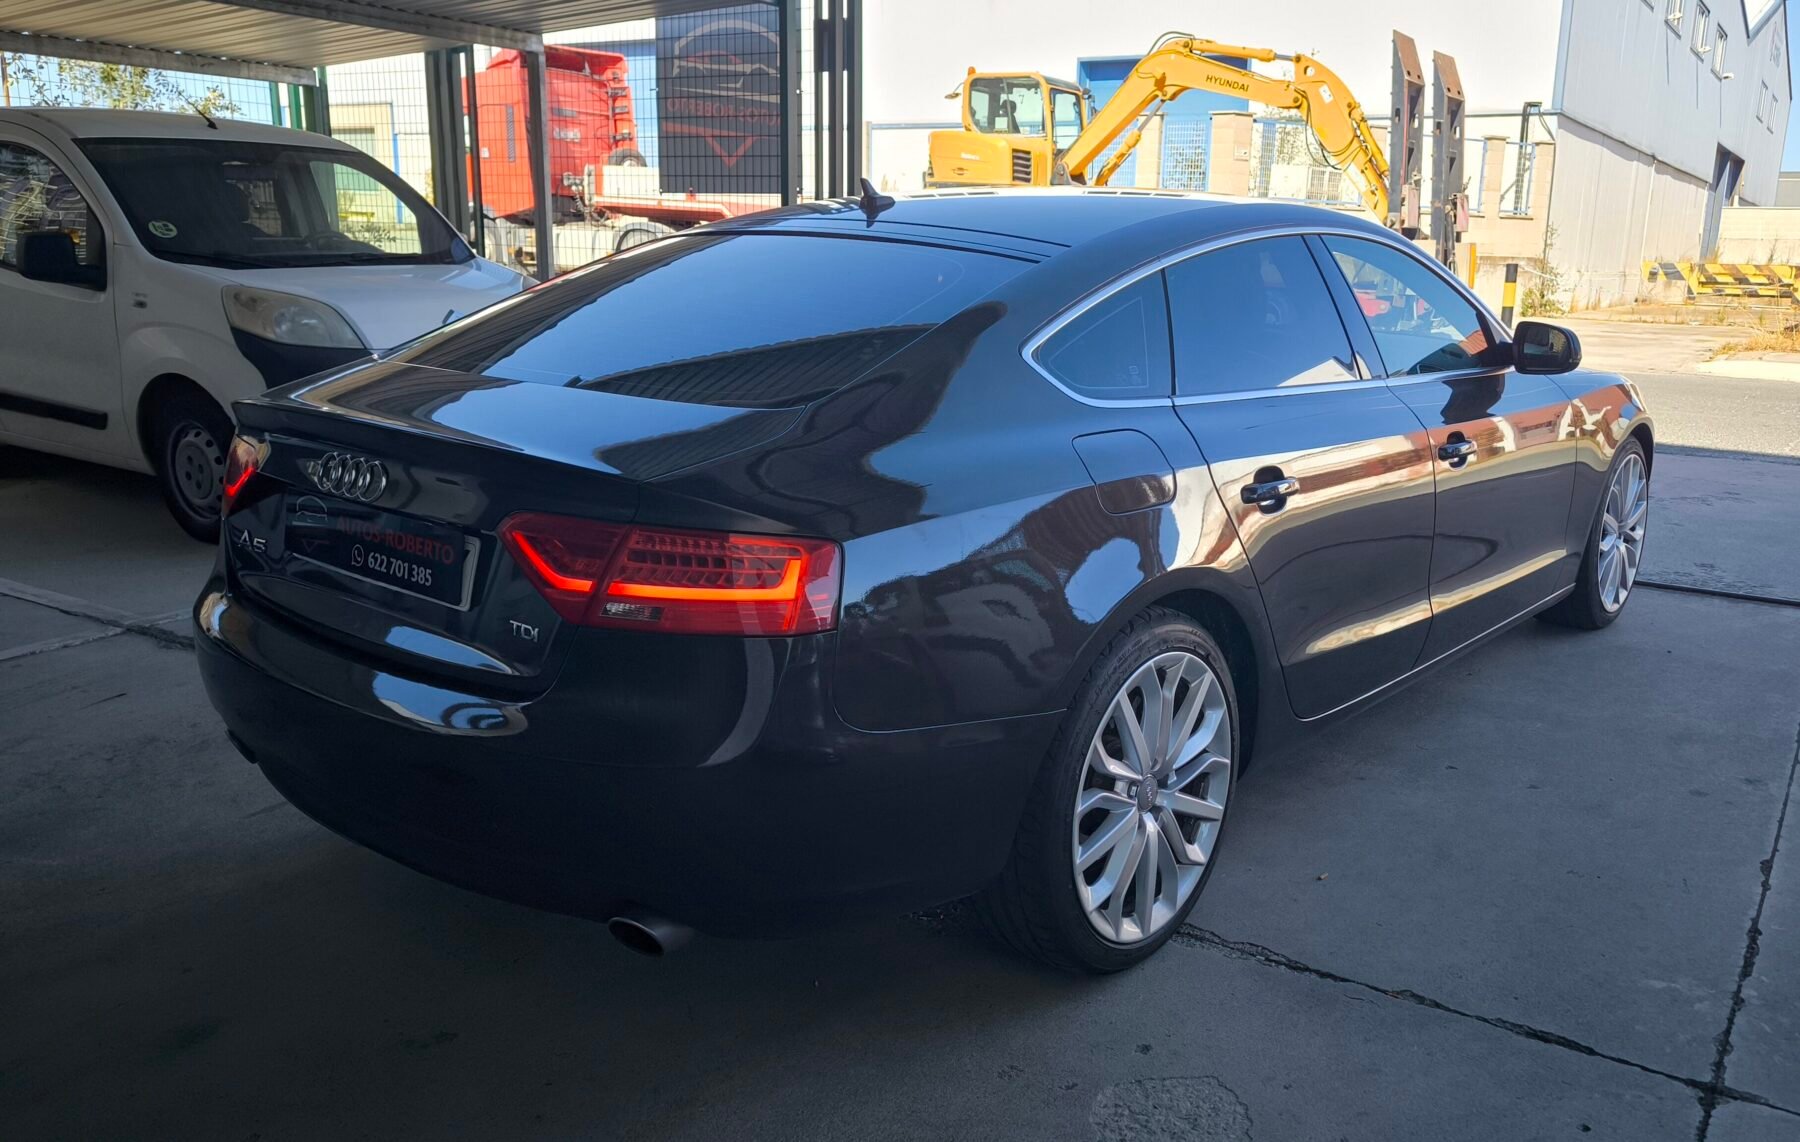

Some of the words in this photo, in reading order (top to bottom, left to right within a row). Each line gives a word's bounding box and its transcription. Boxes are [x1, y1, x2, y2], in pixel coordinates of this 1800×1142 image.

[1206, 74, 1249, 92] HYUNDAI
[236, 529, 267, 552] A5
[368, 552, 388, 573] 622
[390, 558, 409, 580] 701
[411, 564, 432, 587] 385
[509, 619, 540, 643] TDI
